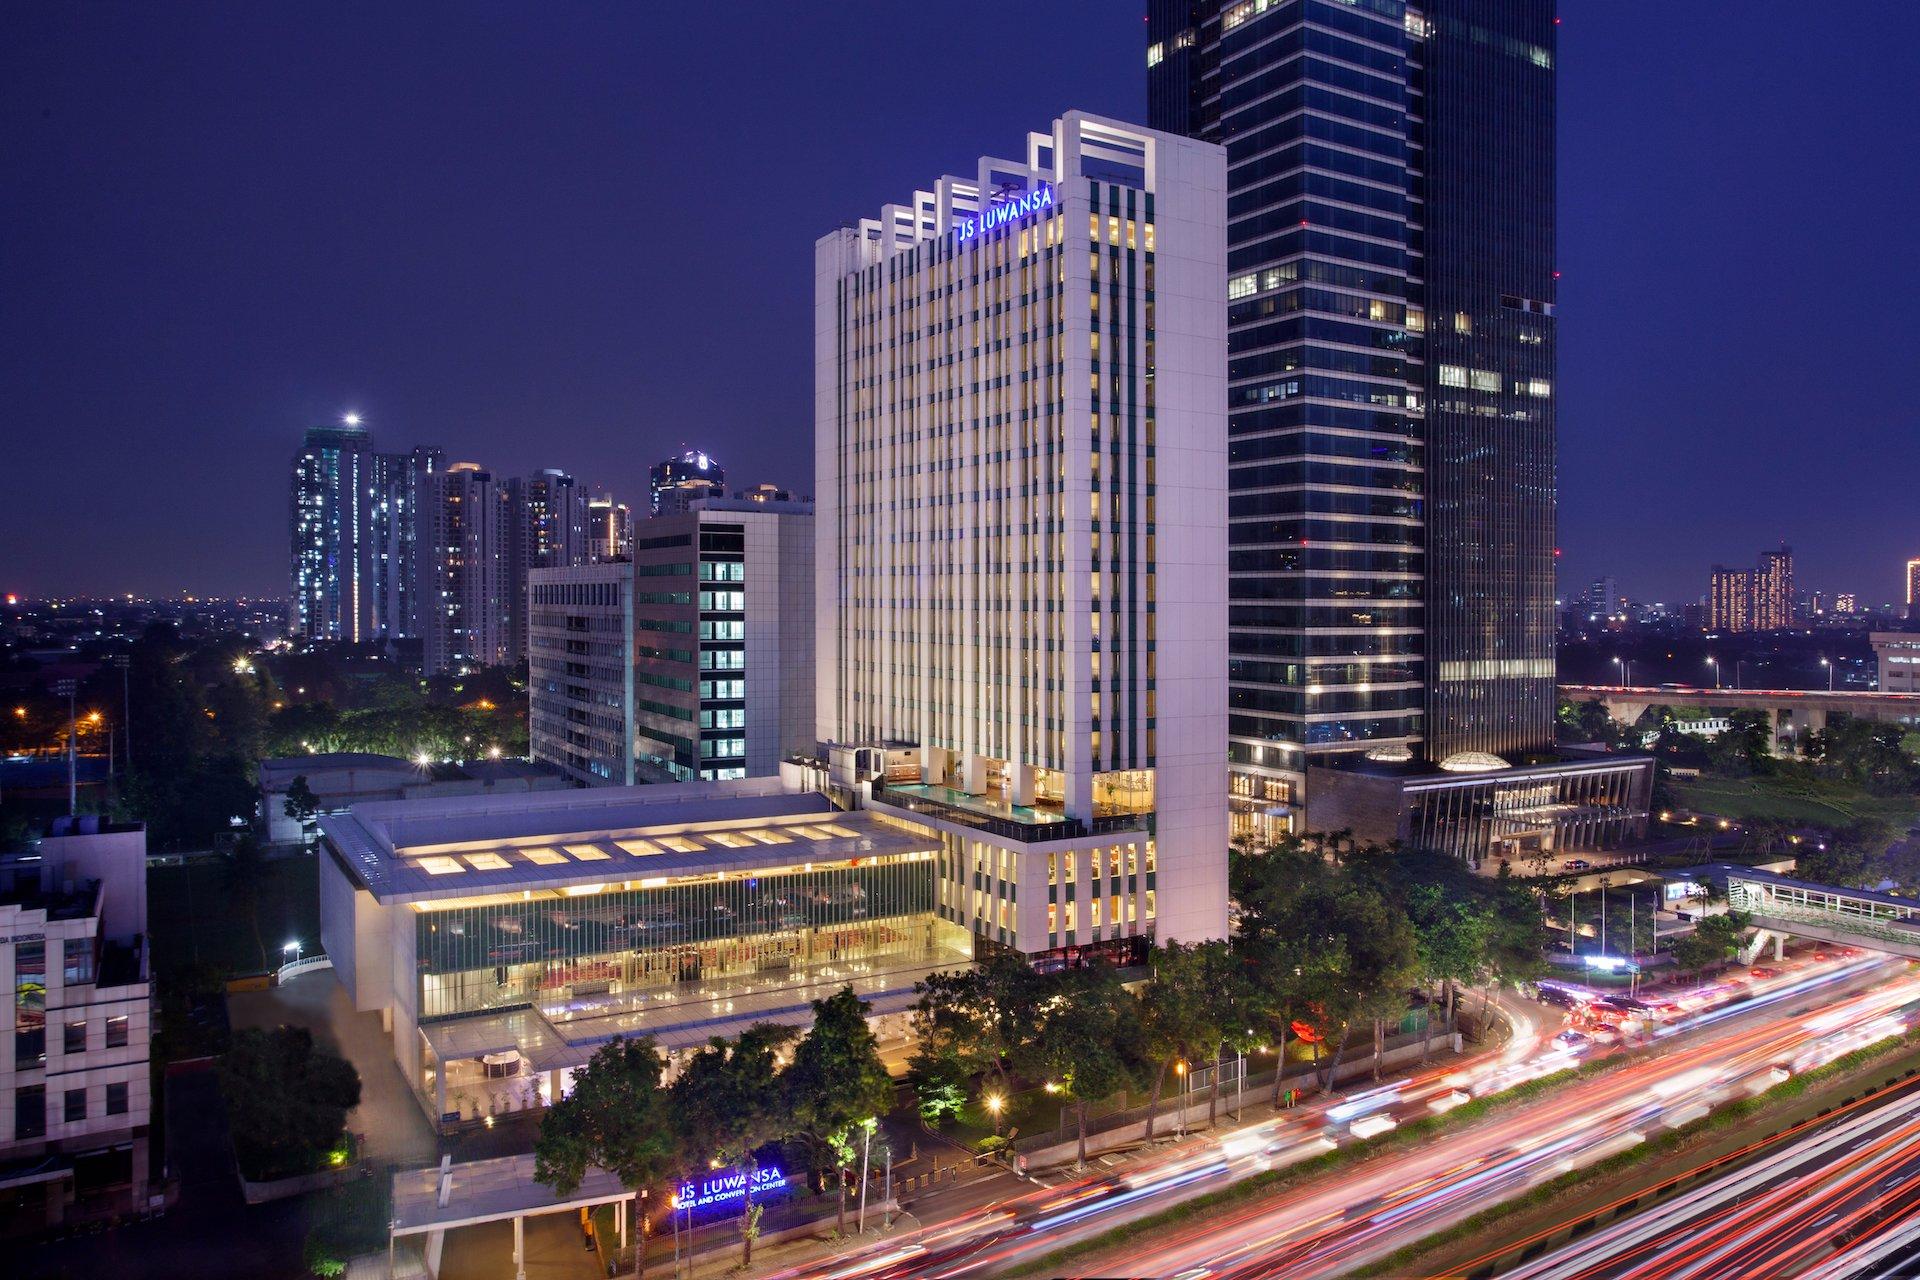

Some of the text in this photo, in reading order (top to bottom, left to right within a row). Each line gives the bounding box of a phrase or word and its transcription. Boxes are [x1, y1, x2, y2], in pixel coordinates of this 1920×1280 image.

[960, 187, 1052, 241] JS LUWANSA
[679, 1167, 781, 1201] JS LUWANSA
[697, 1195, 714, 1206] AND
[714, 1185, 761, 1202] CONVENON
[761, 1179, 786, 1191] CENTER
